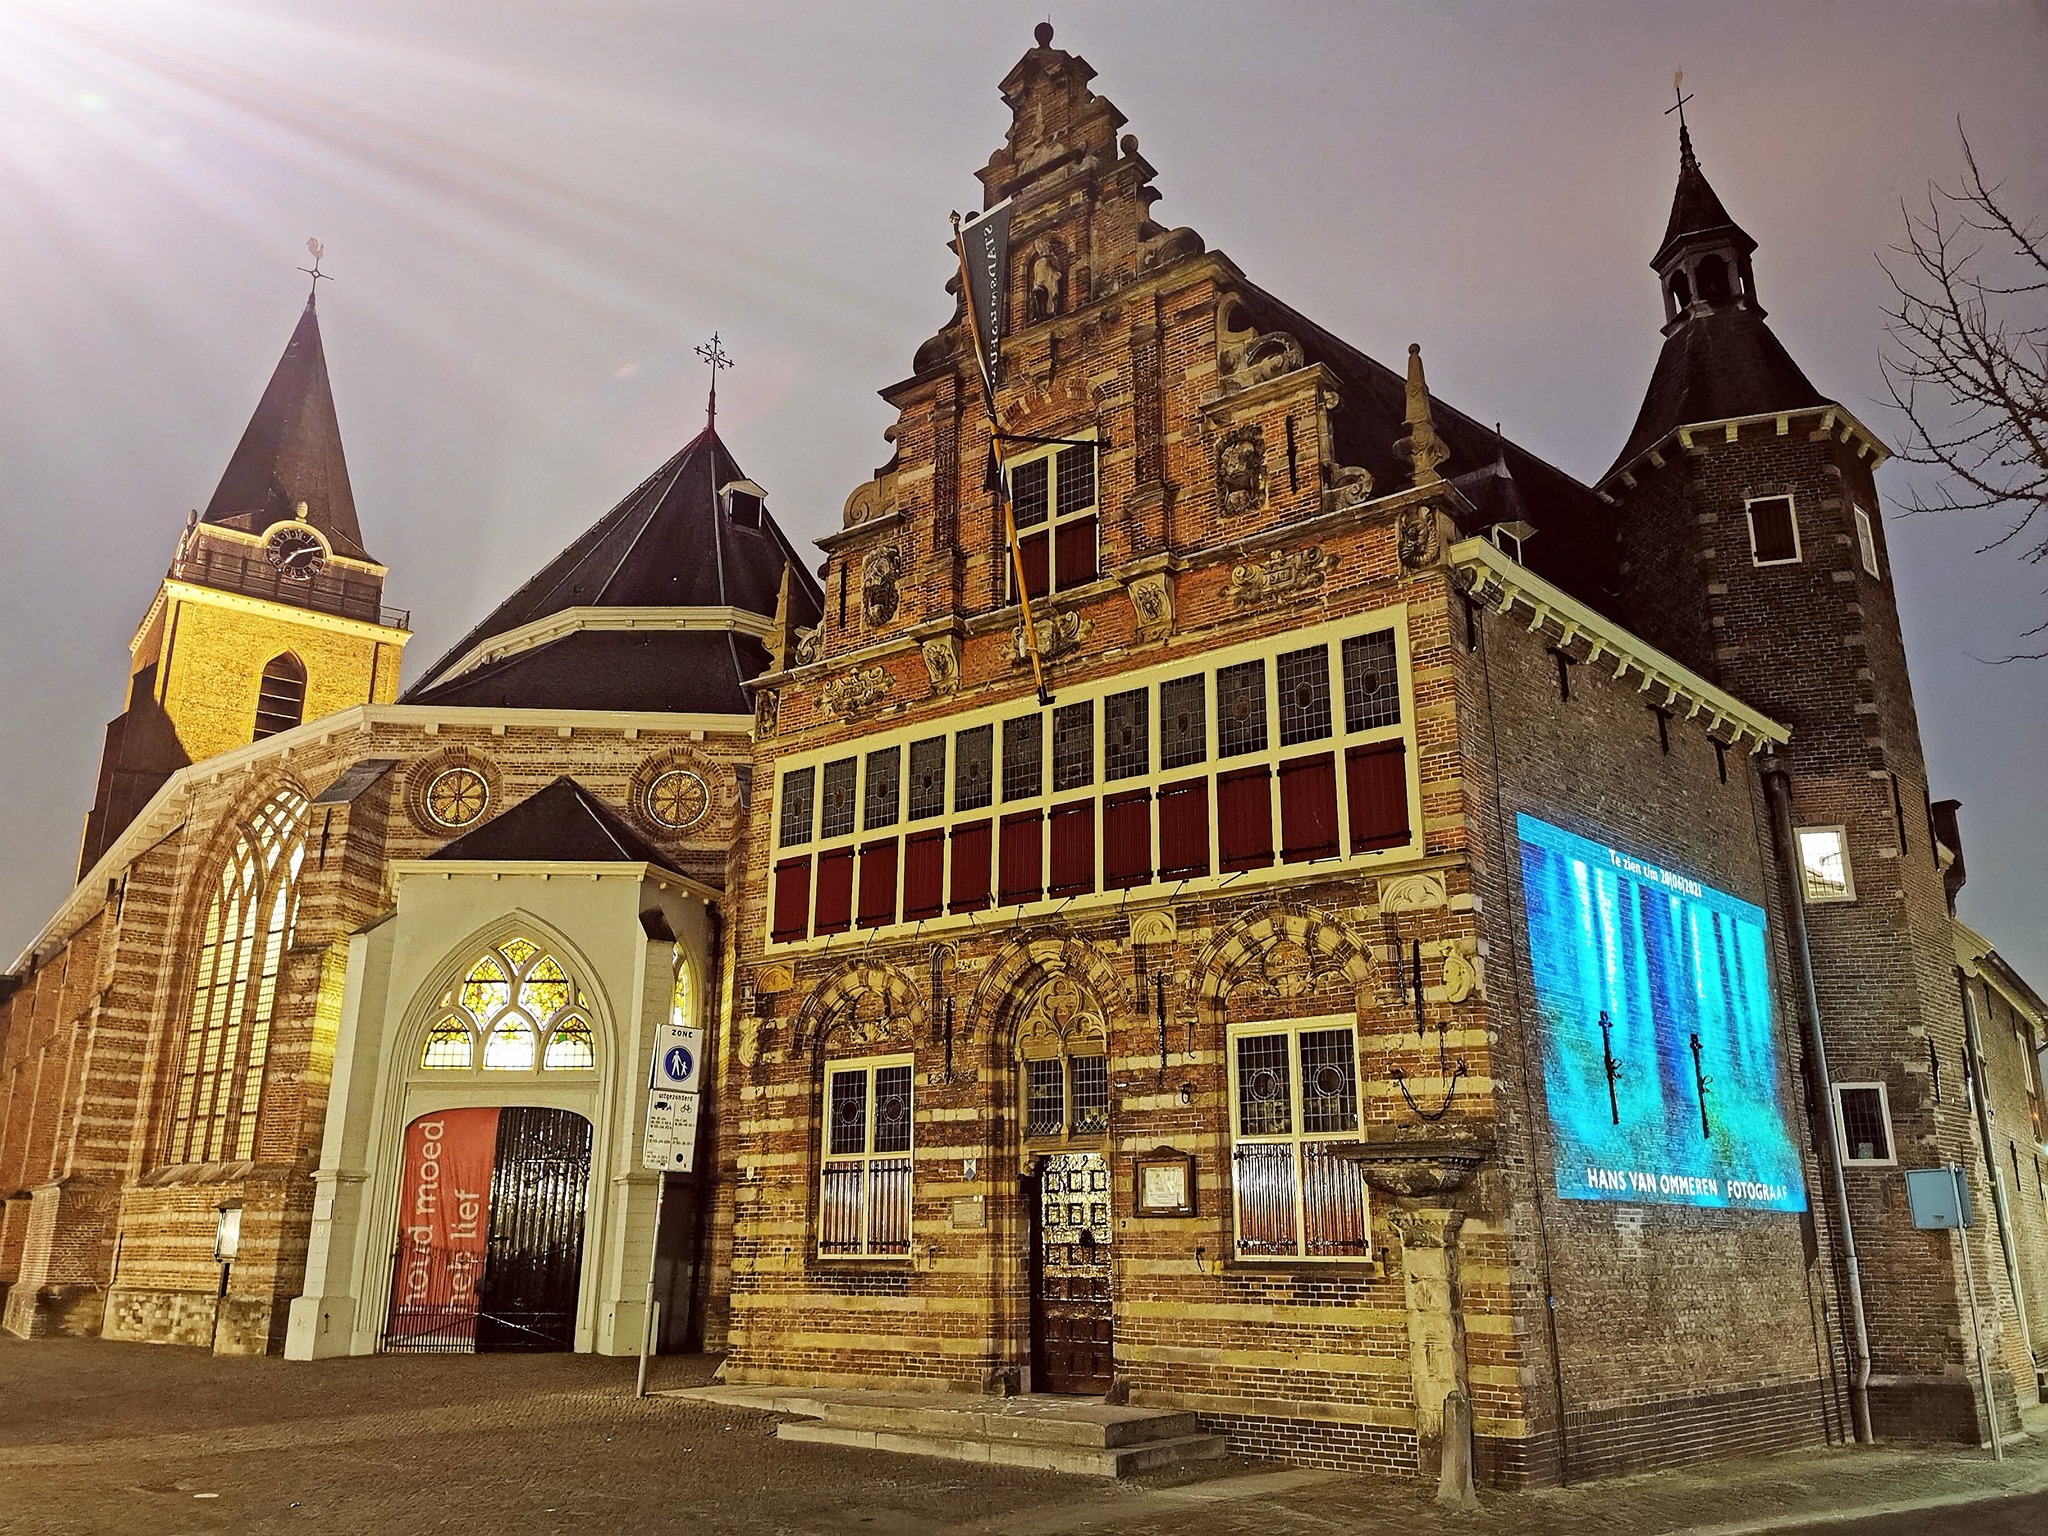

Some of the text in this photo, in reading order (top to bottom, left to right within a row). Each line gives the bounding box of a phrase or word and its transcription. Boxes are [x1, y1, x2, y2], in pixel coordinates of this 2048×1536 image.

[1608, 849, 1621, 867] Te
[1623, 857, 1641, 876] zien
[672, 1029, 693, 1038] ZONE
[658, 1092, 693, 1102] uitgezonderd
[416, 1120, 444, 1214] moed
[1587, 1168, 1787, 1200] HANS VAN OMMEREN FOTOGRAAF
[451, 1189, 480, 1239] lief
